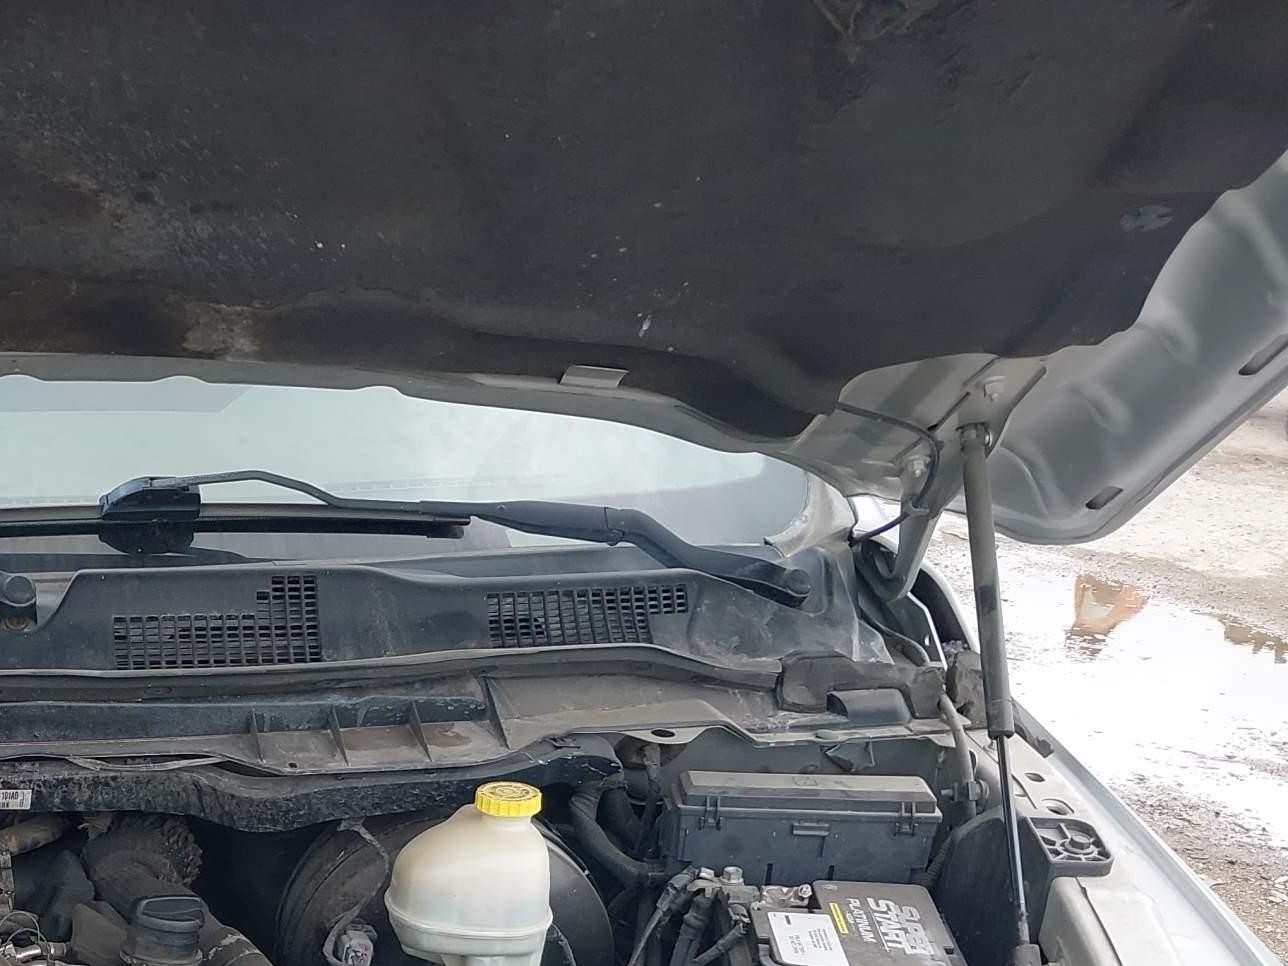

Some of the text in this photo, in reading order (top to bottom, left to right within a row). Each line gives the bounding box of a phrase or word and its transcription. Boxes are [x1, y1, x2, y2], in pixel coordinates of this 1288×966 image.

[846, 898, 877, 943] PLATINUM
[866, 898, 907, 950] START
[898, 906, 934, 955] SUPER
